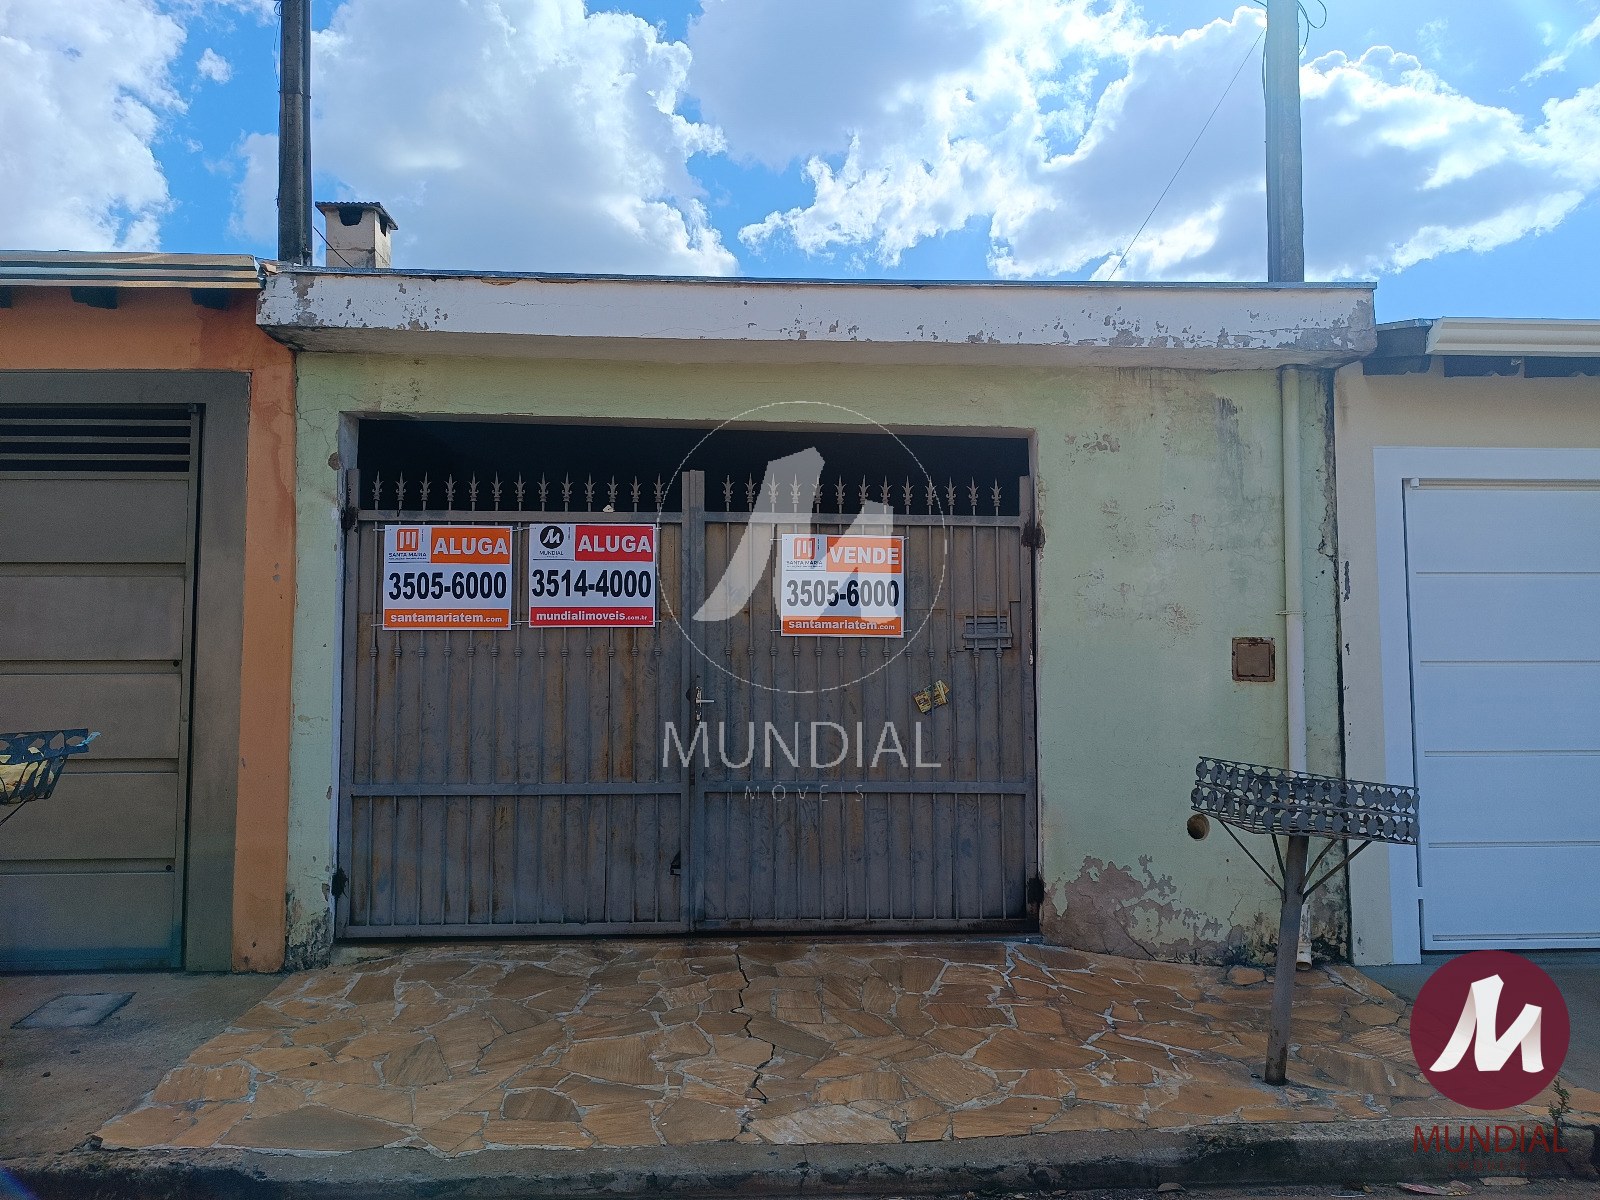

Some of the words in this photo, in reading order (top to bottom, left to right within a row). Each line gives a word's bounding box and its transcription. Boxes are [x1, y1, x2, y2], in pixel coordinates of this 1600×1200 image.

[433, 537, 508, 555] ALUGA
[577, 535, 652, 553] ALUGA
[828, 546, 899, 565] VENDE
[388, 571, 507, 600] 3505-6000
[531, 569, 652, 598] 3514-4000
[786, 579, 900, 607] 3505-6000
[390, 612, 502, 623] santamariatem.com
[788, 619, 895, 630] santamariatem.com
